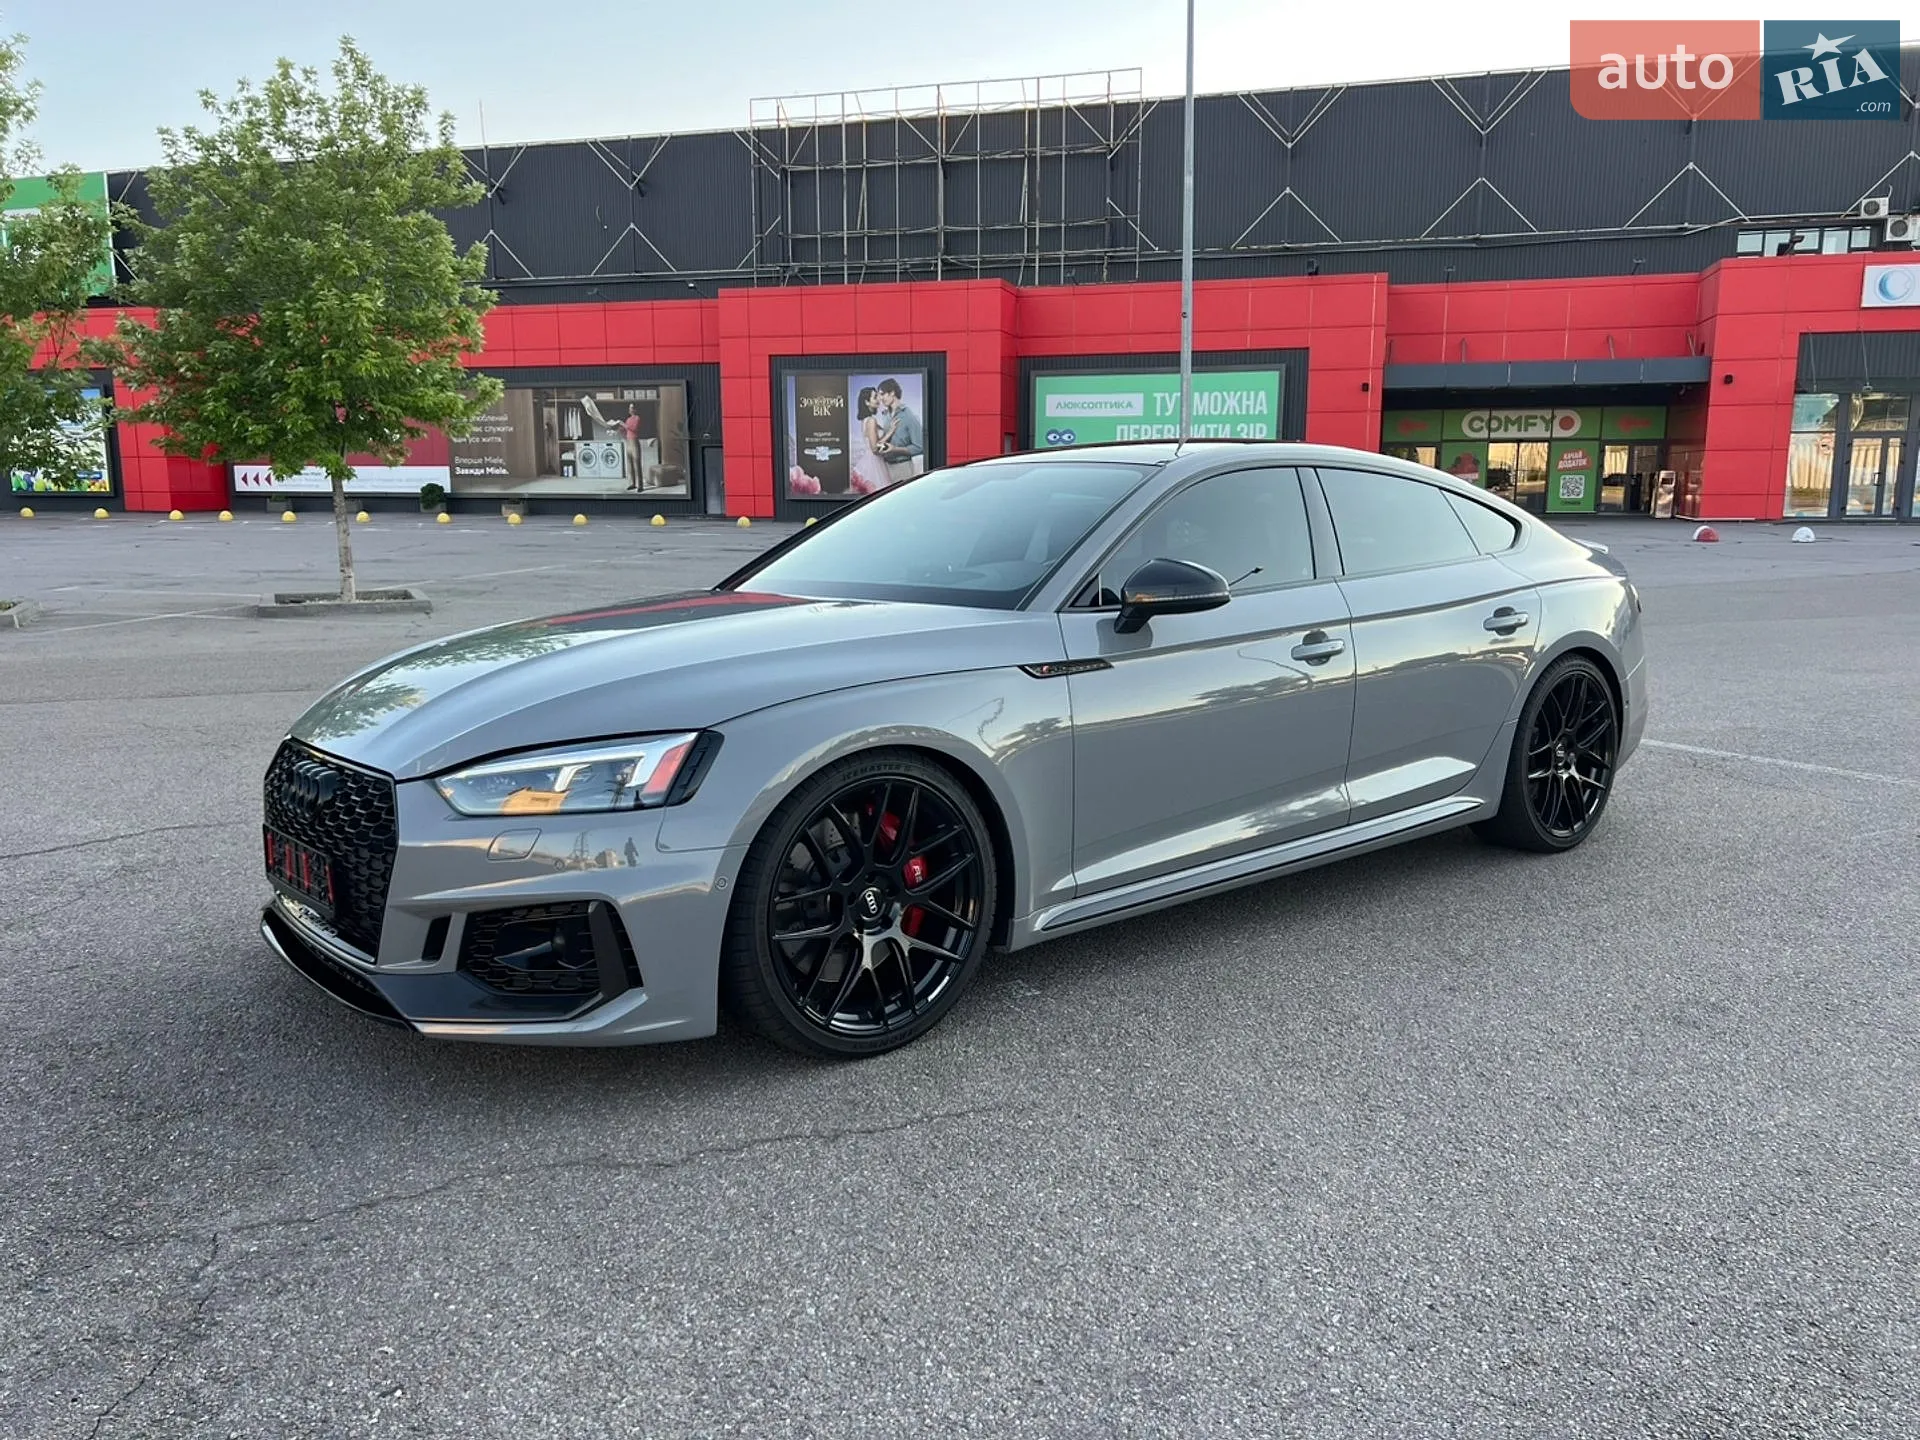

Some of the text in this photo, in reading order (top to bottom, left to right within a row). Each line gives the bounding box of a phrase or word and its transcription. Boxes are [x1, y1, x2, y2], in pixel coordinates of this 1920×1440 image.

[1055, 400, 1134, 410] ЛЮКСОПТИКА
[1153, 390, 1268, 417] ТУ МОЖНА
[1116, 423, 1231, 441] ПЕРЕВІИТИ
[1468, 415, 1556, 433] COMFY
